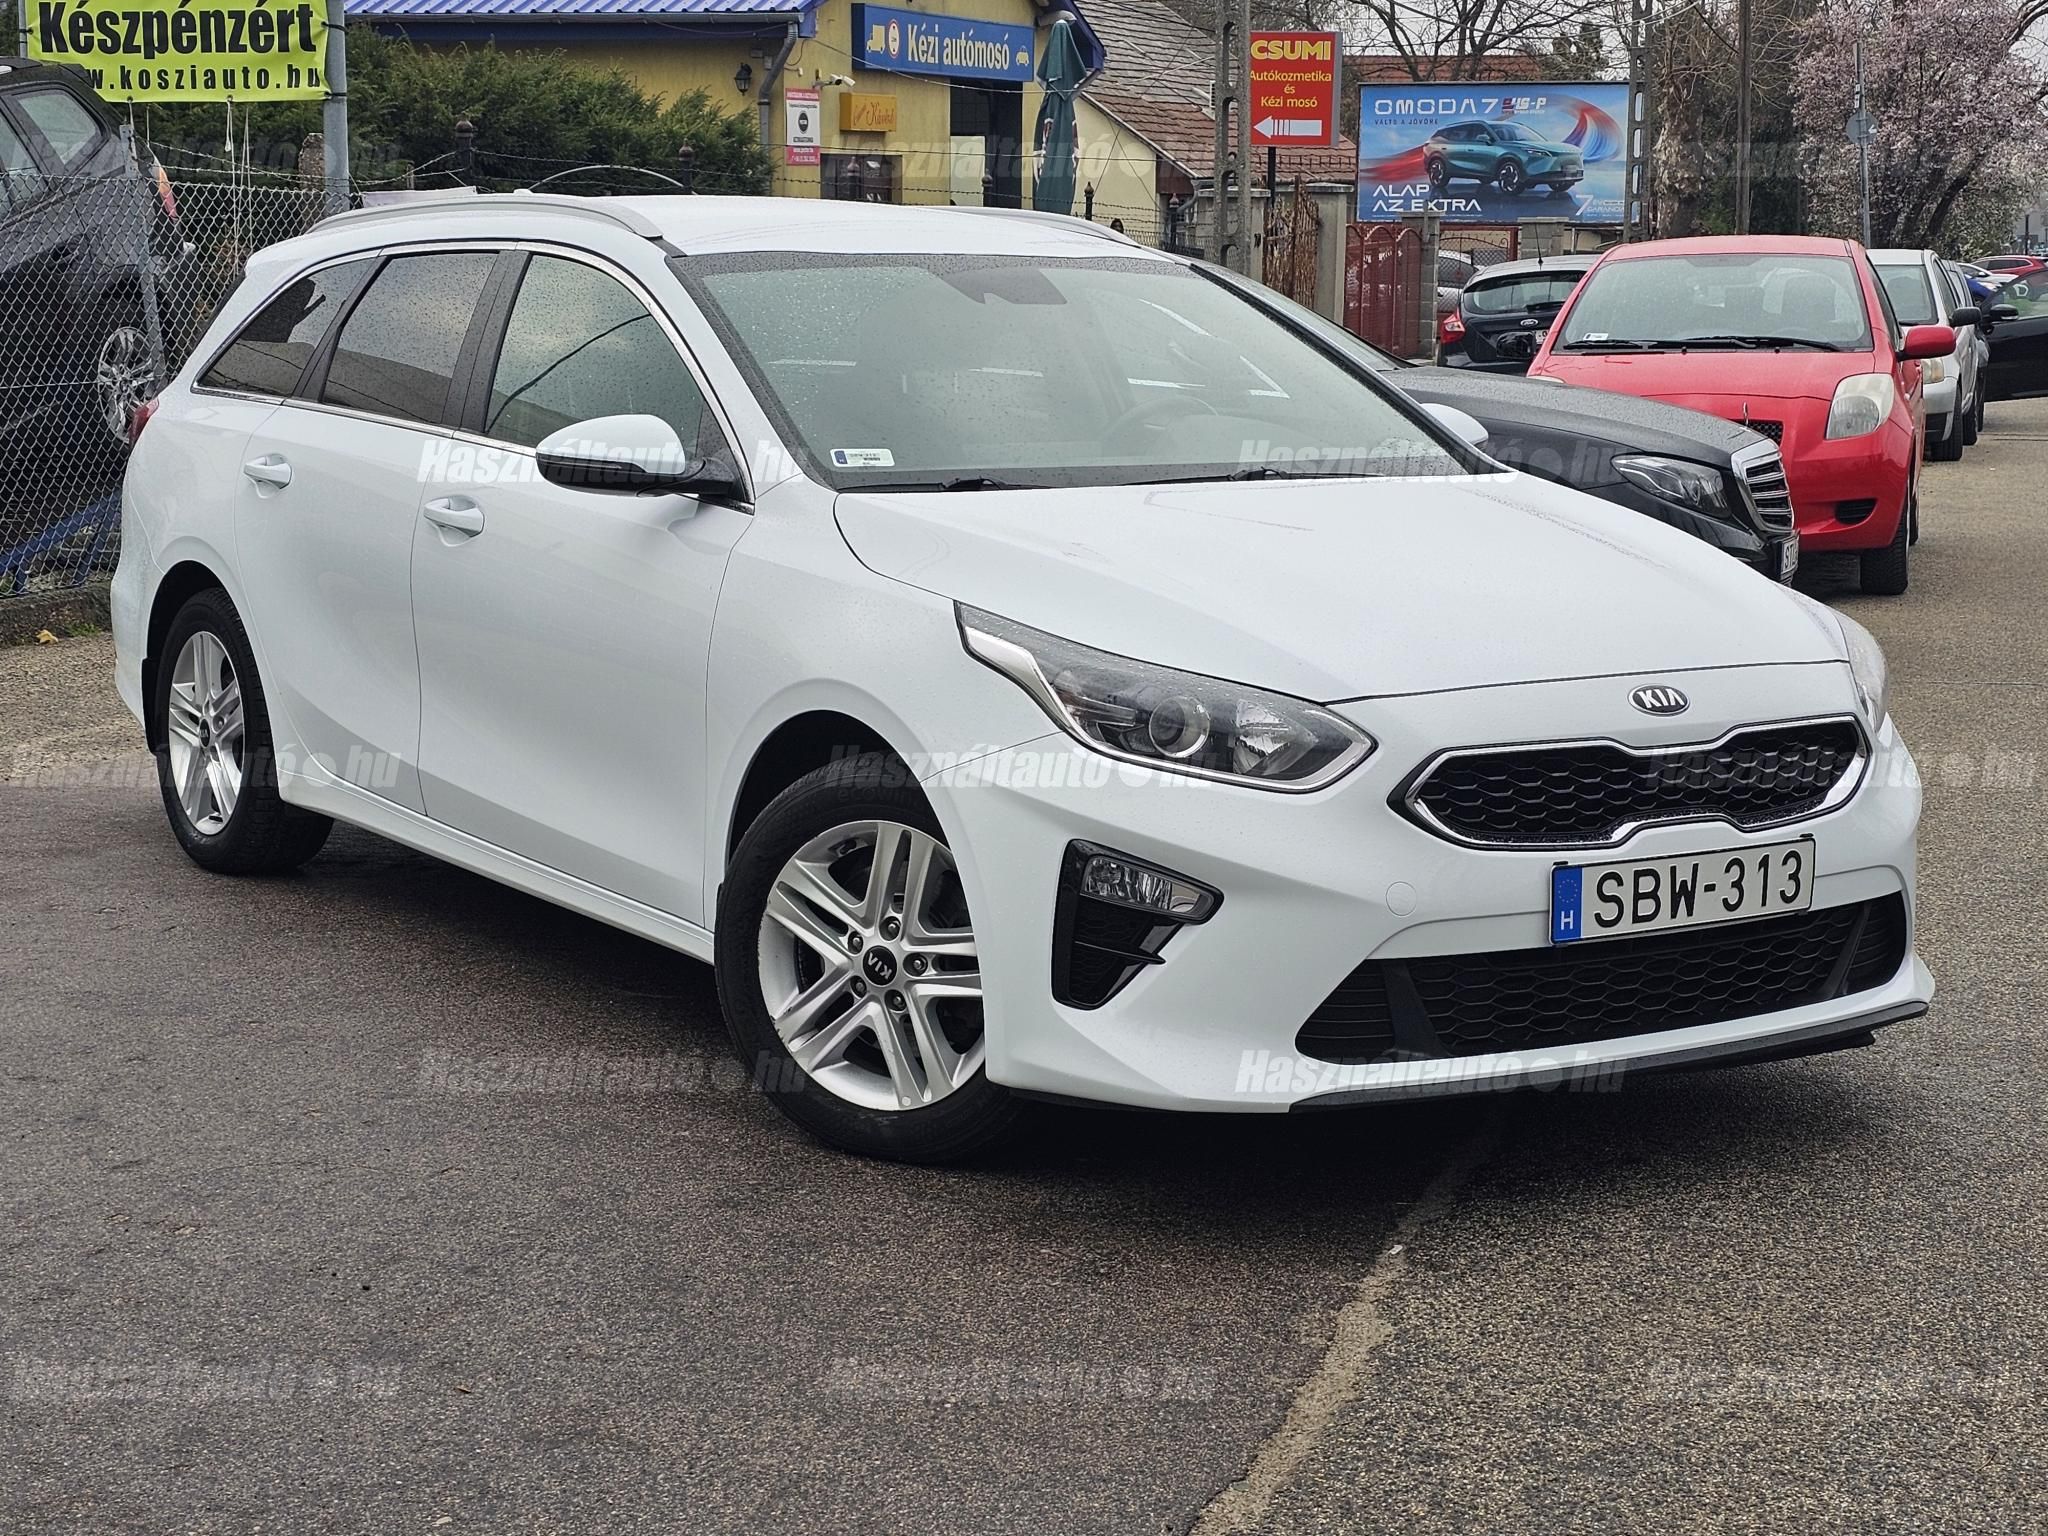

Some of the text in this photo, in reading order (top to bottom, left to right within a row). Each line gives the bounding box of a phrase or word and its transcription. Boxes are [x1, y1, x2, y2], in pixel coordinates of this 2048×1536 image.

[39, 0, 317, 59] Készpénzért
[907, 22, 1010, 71] Kézi autómosó
[1250, 40, 1332, 61] CSUMI
[1249, 69, 1332, 82] Autókozmetika
[1283, 83, 1296, 95] és
[1260, 96, 1318, 108] Kézi mosó
[1374, 98, 1477, 115] OMODA
[1481, 98, 1498, 114] 7
[1372, 184, 1430, 197] ALAP
[1372, 199, 1482, 212] AZ EXTRA
[1575, 194, 1594, 216] 7
[1639, 688, 1686, 709] KIA
[1593, 849, 1802, 928] SBW-313
[1560, 911, 1574, 930] H
[867, 952, 892, 980] KIA
